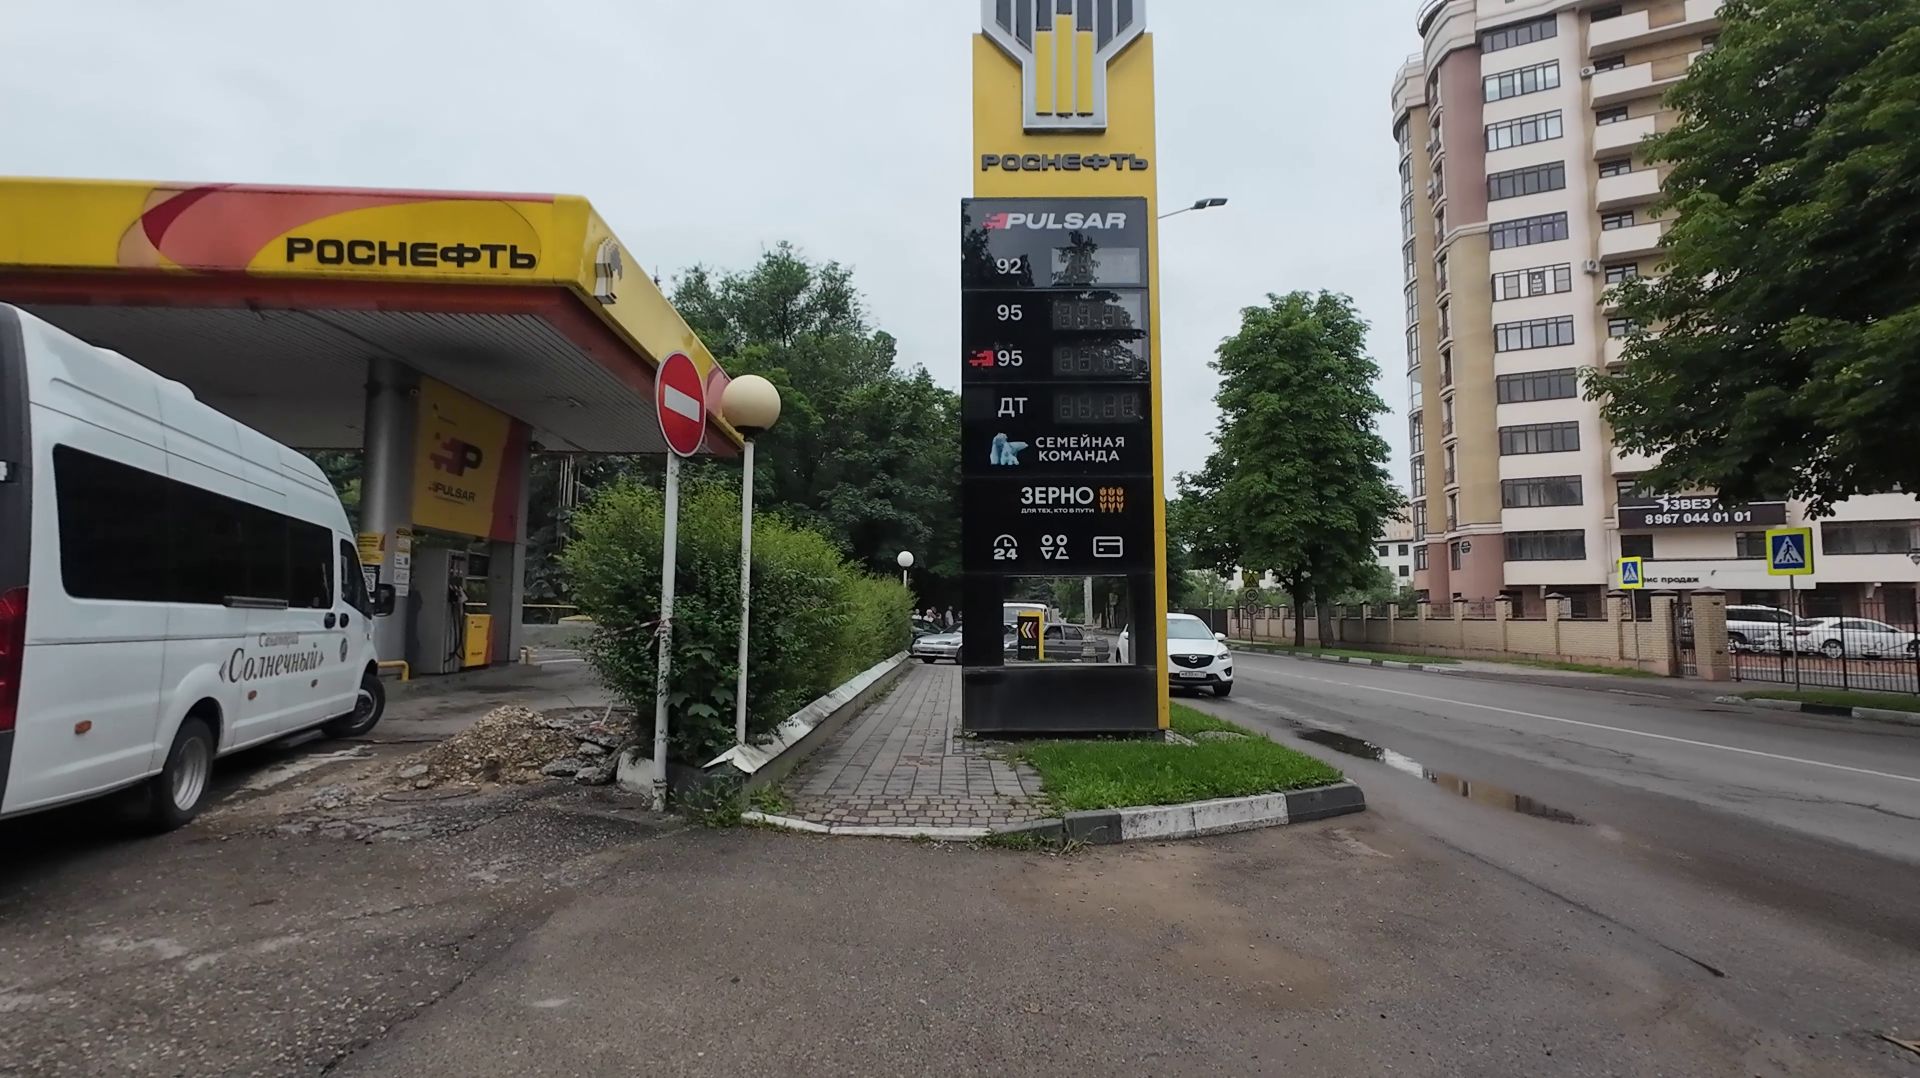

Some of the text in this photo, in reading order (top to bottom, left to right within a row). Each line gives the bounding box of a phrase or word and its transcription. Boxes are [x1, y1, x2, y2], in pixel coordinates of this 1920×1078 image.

[981, 153, 1149, 172] РОСНЕФТЬ
[1005, 212, 1127, 230] PULSAR
[286, 237, 537, 270] РОСНЕФТЬ
[996, 258, 1022, 275] 92
[996, 304, 1023, 321] 95
[997, 350, 1023, 367] 95
[997, 397, 1028, 418] ДТ
[1035, 434, 1125, 448] СЕМЕЙНАЯ
[1038, 450, 1120, 463] КОМАНДА
[1020, 486, 1095, 505] ЗЕРНО
[1683, 512, 1710, 524] 044
[1712, 511, 1729, 523] 01
[1734, 511, 1752, 522] 01
[993, 548, 1018, 560] 24
[1661, 576, 1700, 584] продаж
[219, 641, 324, 683] «Солнечный»
